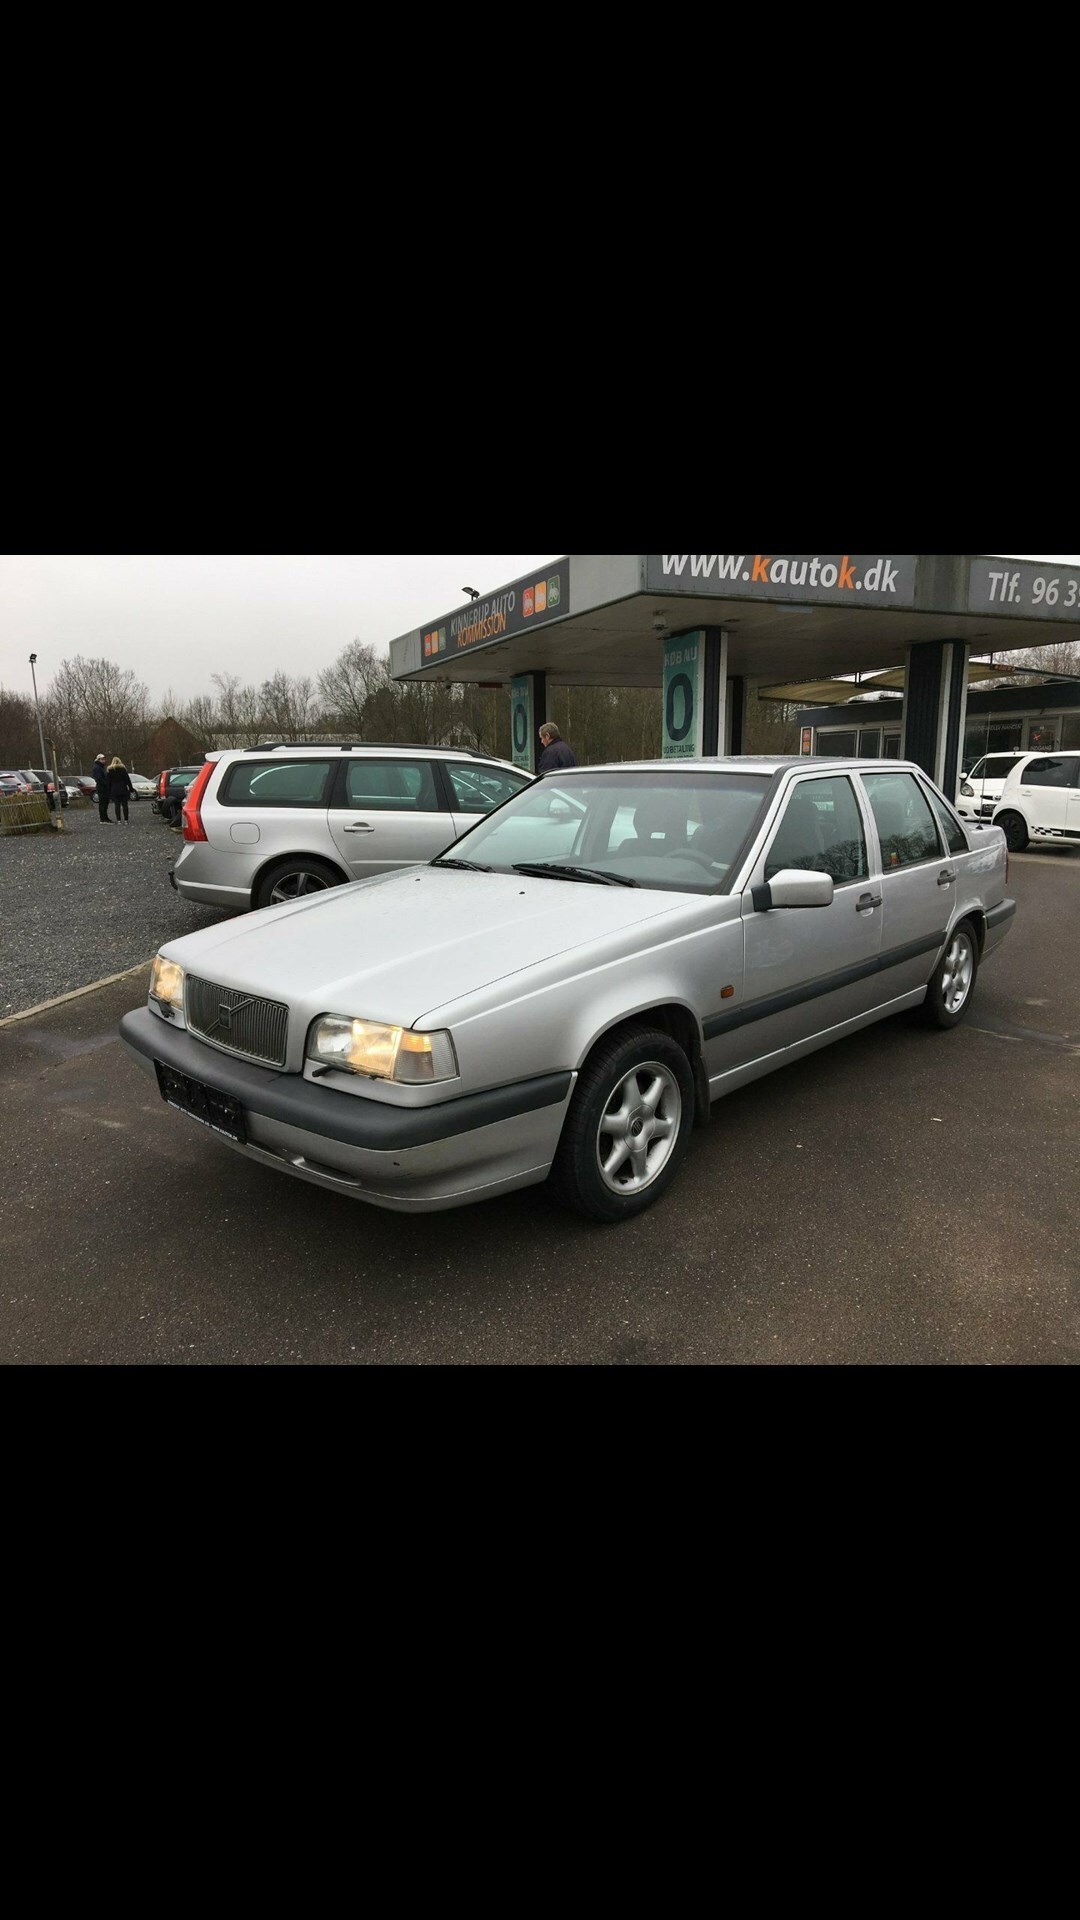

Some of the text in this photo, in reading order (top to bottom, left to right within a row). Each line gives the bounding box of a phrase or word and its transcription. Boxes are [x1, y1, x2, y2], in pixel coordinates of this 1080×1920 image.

[661, 555, 899, 593] www.kautok.dk
[988, 572, 1080, 608] Tlf. 96 3
[450, 590, 516, 637] KINNERUP AUTO
[457, 612, 507, 648] KOMMISSION
